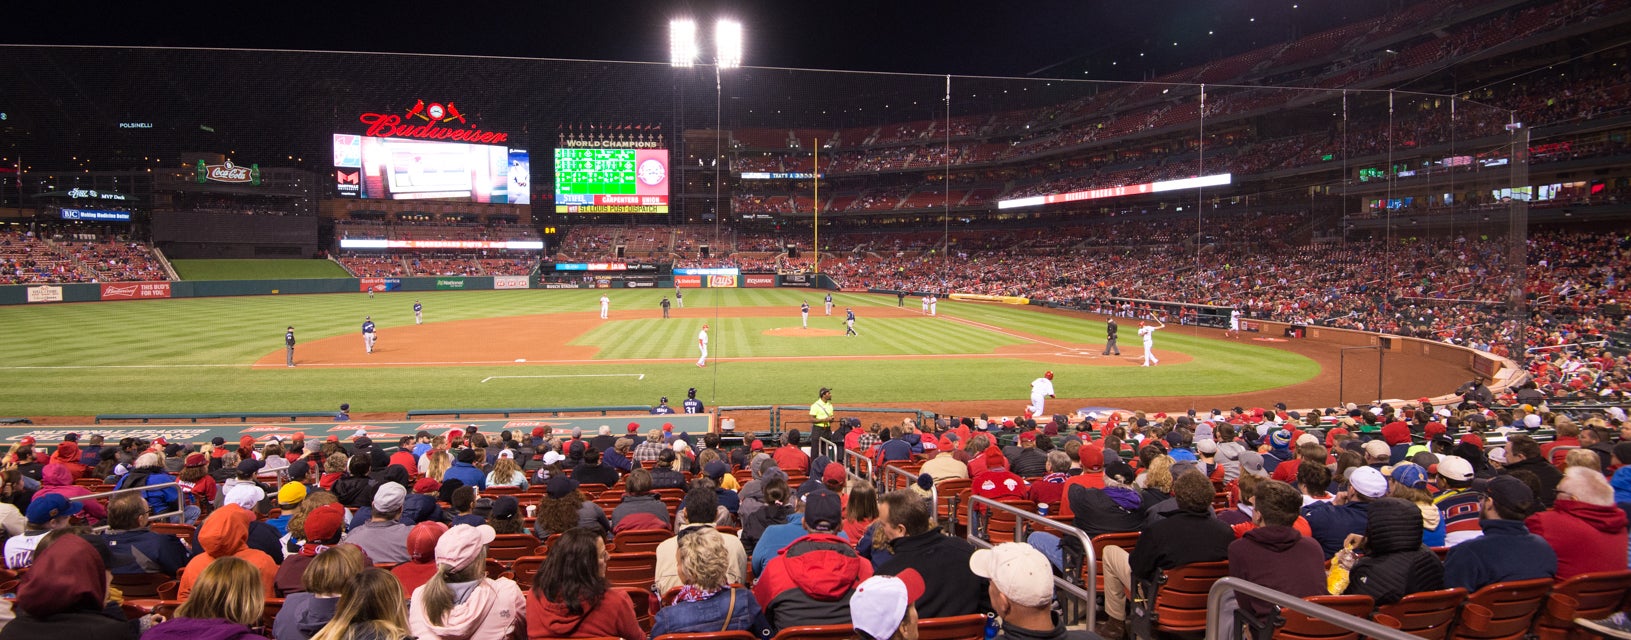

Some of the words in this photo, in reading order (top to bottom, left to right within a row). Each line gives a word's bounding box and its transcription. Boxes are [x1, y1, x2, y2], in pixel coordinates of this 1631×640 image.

[360, 112, 507, 143] Budweiser
[567, 140, 600, 148] WORLD
[602, 140, 656, 148] CHAMPIONS
[685, 406, 696, 415] 31
